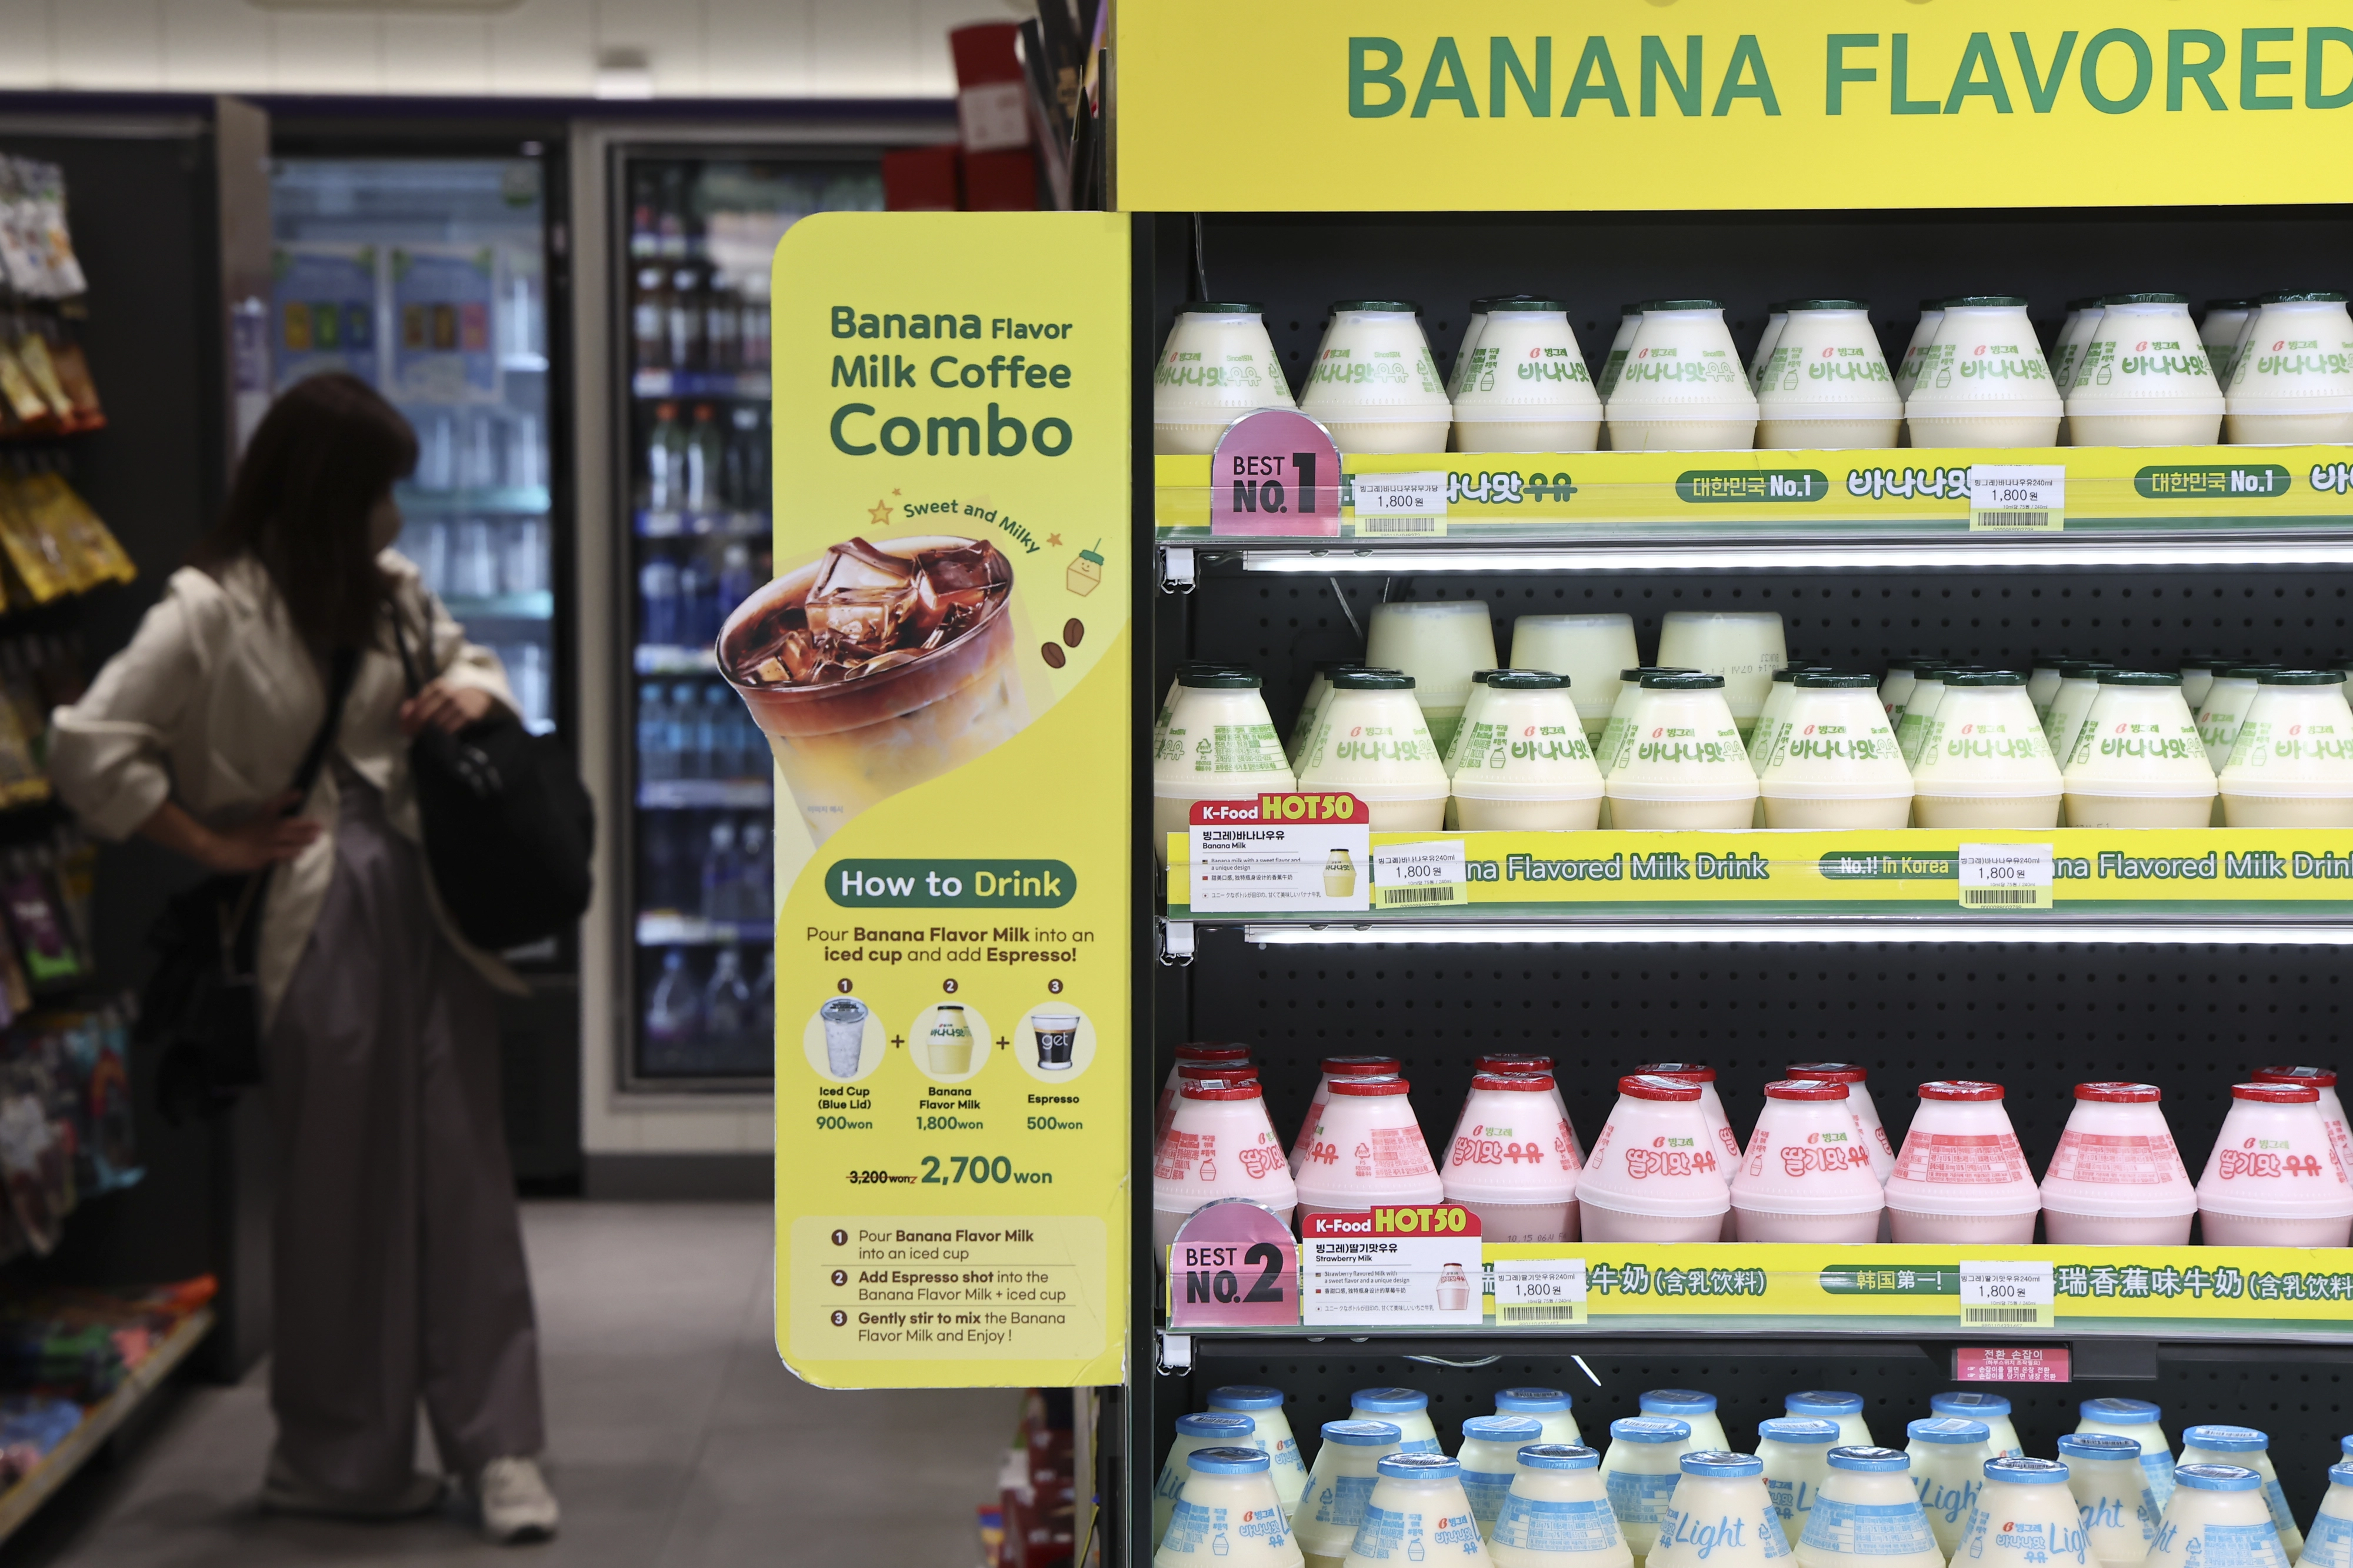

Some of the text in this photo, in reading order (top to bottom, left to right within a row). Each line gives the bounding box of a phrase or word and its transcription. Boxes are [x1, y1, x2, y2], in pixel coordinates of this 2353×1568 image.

[1348, 27, 2353, 118] BANANA FLAVORED
[832, 306, 1072, 339] Banana Flavor
[1544, 348, 1568, 357] 빙그레
[1838, 348, 1864, 356] 빙그레
[2152, 342, 2179, 351] 빙그레
[1179, 352, 1201, 361] 빙그레
[831, 355, 1071, 388] Milk Coffee
[830, 402, 1072, 456] Combo
[1234, 456, 1285, 475] BEST
[1693, 475, 1811, 496] 대한민국 No.1
[2152, 470, 2272, 492] 대한민국 No.1
[904, 499, 1040, 554] Sweet and Milky
[1366, 726, 1392, 736] 빙그레
[1668, 728, 1695, 737] 빙그레
[1977, 724, 2005, 733] 빙그레
[2308, 725, 2335, 734] 빙그레
[1203, 796, 1354, 819] K-Food HOT50
[1203, 830, 1285, 840] 빙그레)바나나우유
[1508, 855, 1621, 879] Flavored
[1632, 854, 1688, 879] Milk
[1697, 854, 1767, 879] Drink
[1883, 856, 1897, 873] in
[1901, 858, 1948, 873] Korea
[2100, 853, 2353, 878] Flavored Milk Drin
[842, 870, 1062, 897] How to Drink
[807, 927, 1094, 942] Pour Banana Flavor Milk into an
[825, 947, 1076, 965] iced cup and add Espresso!
[1042, 1032, 1068, 1050] get
[819, 1087, 869, 1099] Iced Cup
[929, 1087, 971, 1096] Banana
[818, 1100, 871, 1109] (Blue Lid)
[920, 1100, 981, 1109] Flavor Milk
[1028, 1095, 1079, 1105] Espresso
[816, 1116, 872, 1130] 900won
[916, 1116, 983, 1130] 1,800won
[1027, 1116, 1082, 1130] 500won
[1668, 1138, 1694, 1147] 빙그레
[2259, 1140, 2289, 1149] 빙그레
[921, 1156, 1052, 1186] 2,700won
[1317, 1209, 1466, 1232] K-Food HOT50
[859, 1230, 1034, 1242] Pour Banana Flavor Milk
[859, 1247, 969, 1262] into an iced cup
[1317, 1244, 1398, 1253] 빙그레)딸기맛우유
[1187, 1248, 1237, 1266] BEST
[859, 1272, 1048, 1286] Add Espresso shot into the
[859, 1289, 1065, 1303] Banana Flavor Milk iced cup
[859, 1312, 1065, 1327] Gently stir to mix the Banana
[858, 1330, 1005, 1344] Flavor Milk and Enjoy
[1985, 1350, 2042, 1359] 전환 손잡이
[1448, 1514, 1468, 1526] 빙그레
[2015, 1523, 2042, 1532] 빙그레
[1675, 1513, 1745, 1559] Light
